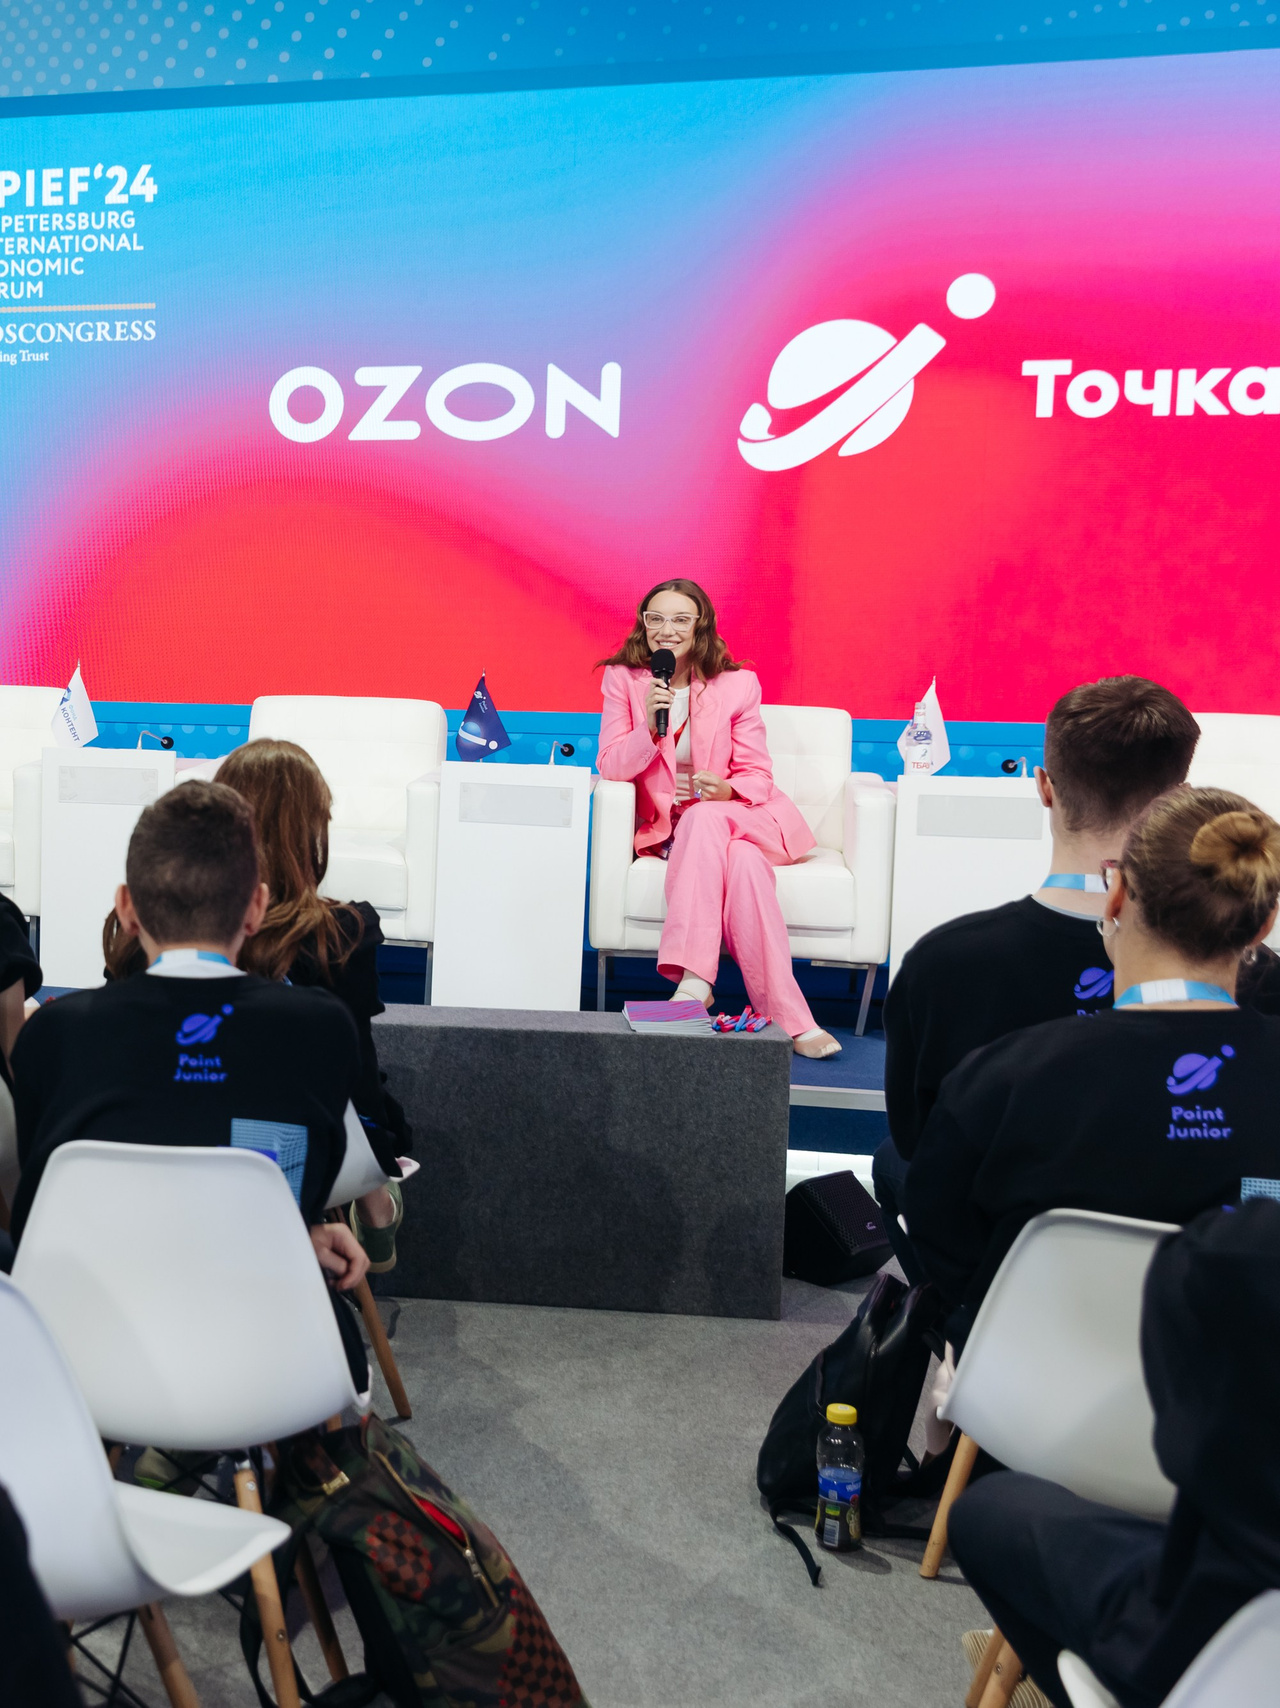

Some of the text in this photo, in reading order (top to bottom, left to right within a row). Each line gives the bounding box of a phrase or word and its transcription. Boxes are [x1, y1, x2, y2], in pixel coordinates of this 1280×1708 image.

[1, 210, 135, 233] PETERSBURG
[19, 350, 49, 363] Trust
[1021, 359, 1280, 418] Точка
[269, 361, 622, 444] OZON
[61, 707, 80, 741] КОНТЕНТ
[179, 1053, 221, 1067] Point
[174, 1068, 227, 1082] Junior
[1171, 1105, 1225, 1122] Point
[1166, 1123, 1232, 1140] Junior
